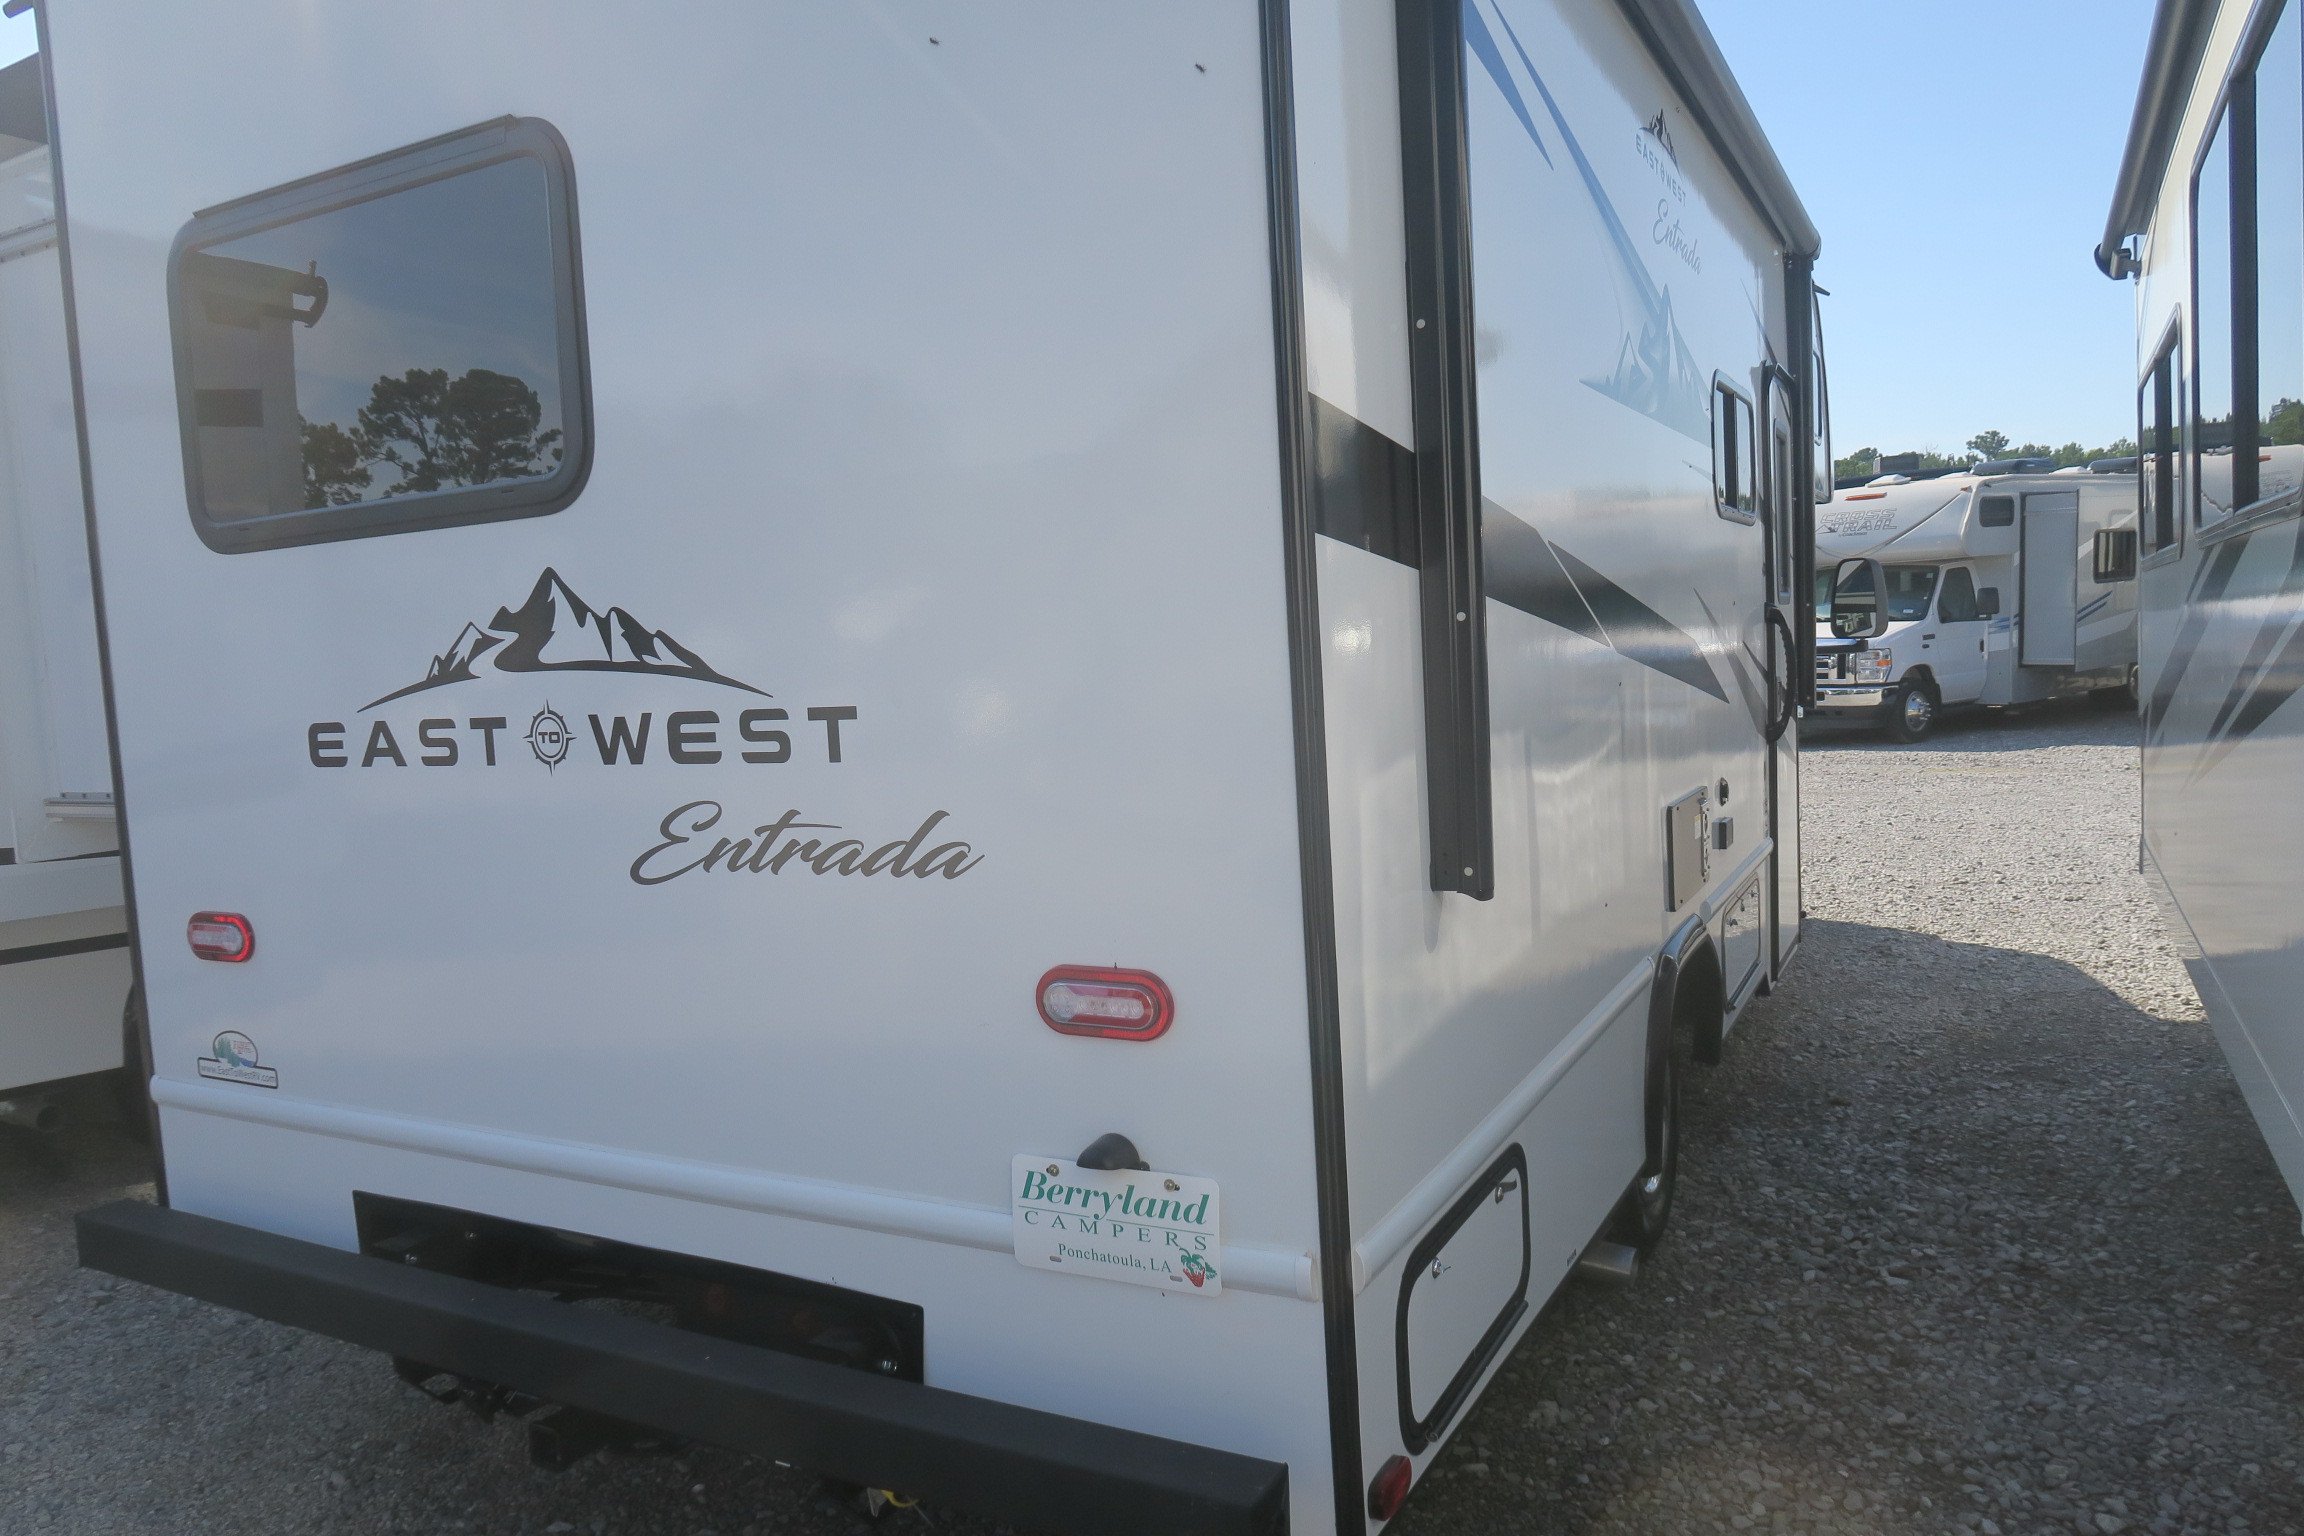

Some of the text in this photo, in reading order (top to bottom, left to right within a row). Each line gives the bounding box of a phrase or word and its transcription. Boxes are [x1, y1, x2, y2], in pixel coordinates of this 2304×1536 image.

[1820, 508, 1897, 524] CROSS
[1830, 518, 1897, 533] TRAIL
[308, 705, 858, 767] EAST TO WEST
[630, 800, 985, 886] Entrada
[1020, 1170, 1210, 1225] Berryland
[1024, 1209, 1207, 1251] CAMPERS
[1058, 1243, 1172, 1273] Ponchatoula, LA
